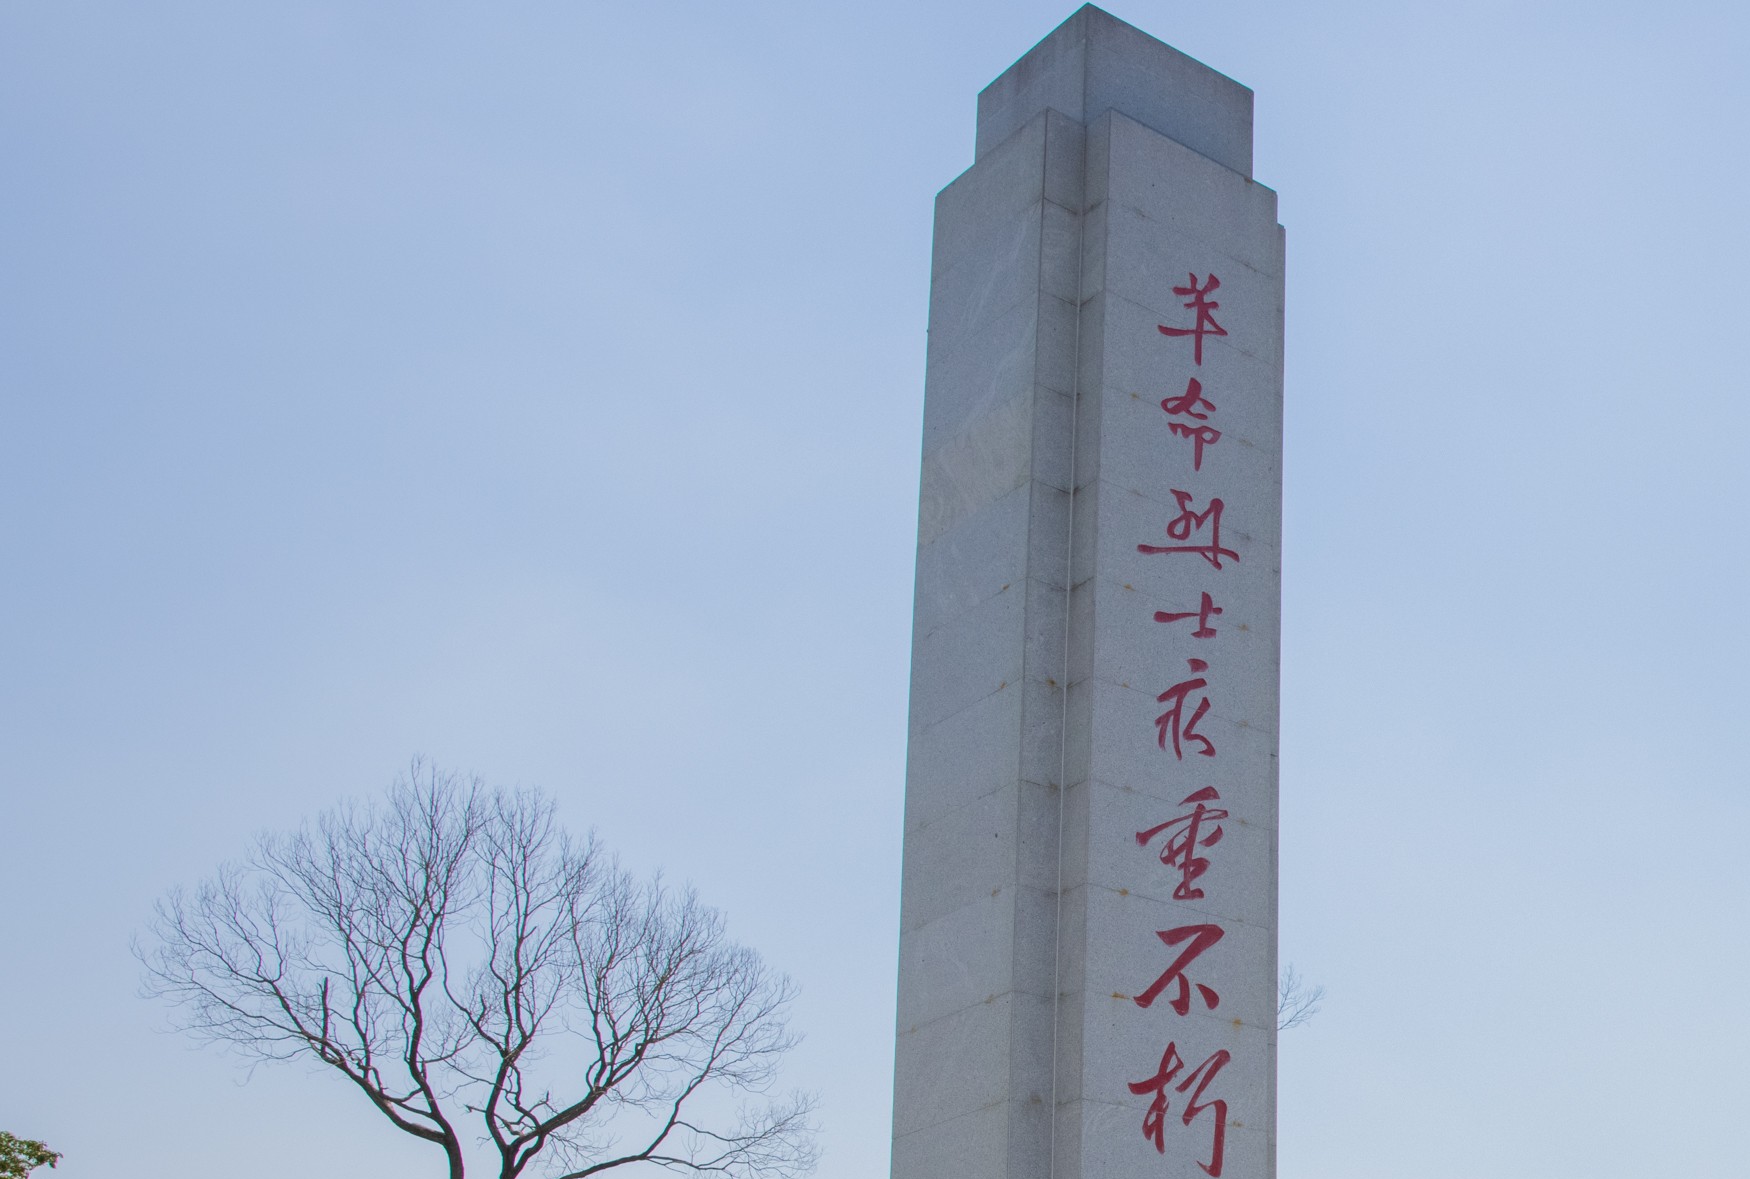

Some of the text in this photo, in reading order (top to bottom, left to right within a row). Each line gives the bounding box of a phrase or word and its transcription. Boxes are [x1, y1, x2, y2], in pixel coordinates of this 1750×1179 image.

[1129, 272, 1239, 1178] 革命烈士永垂不朽
